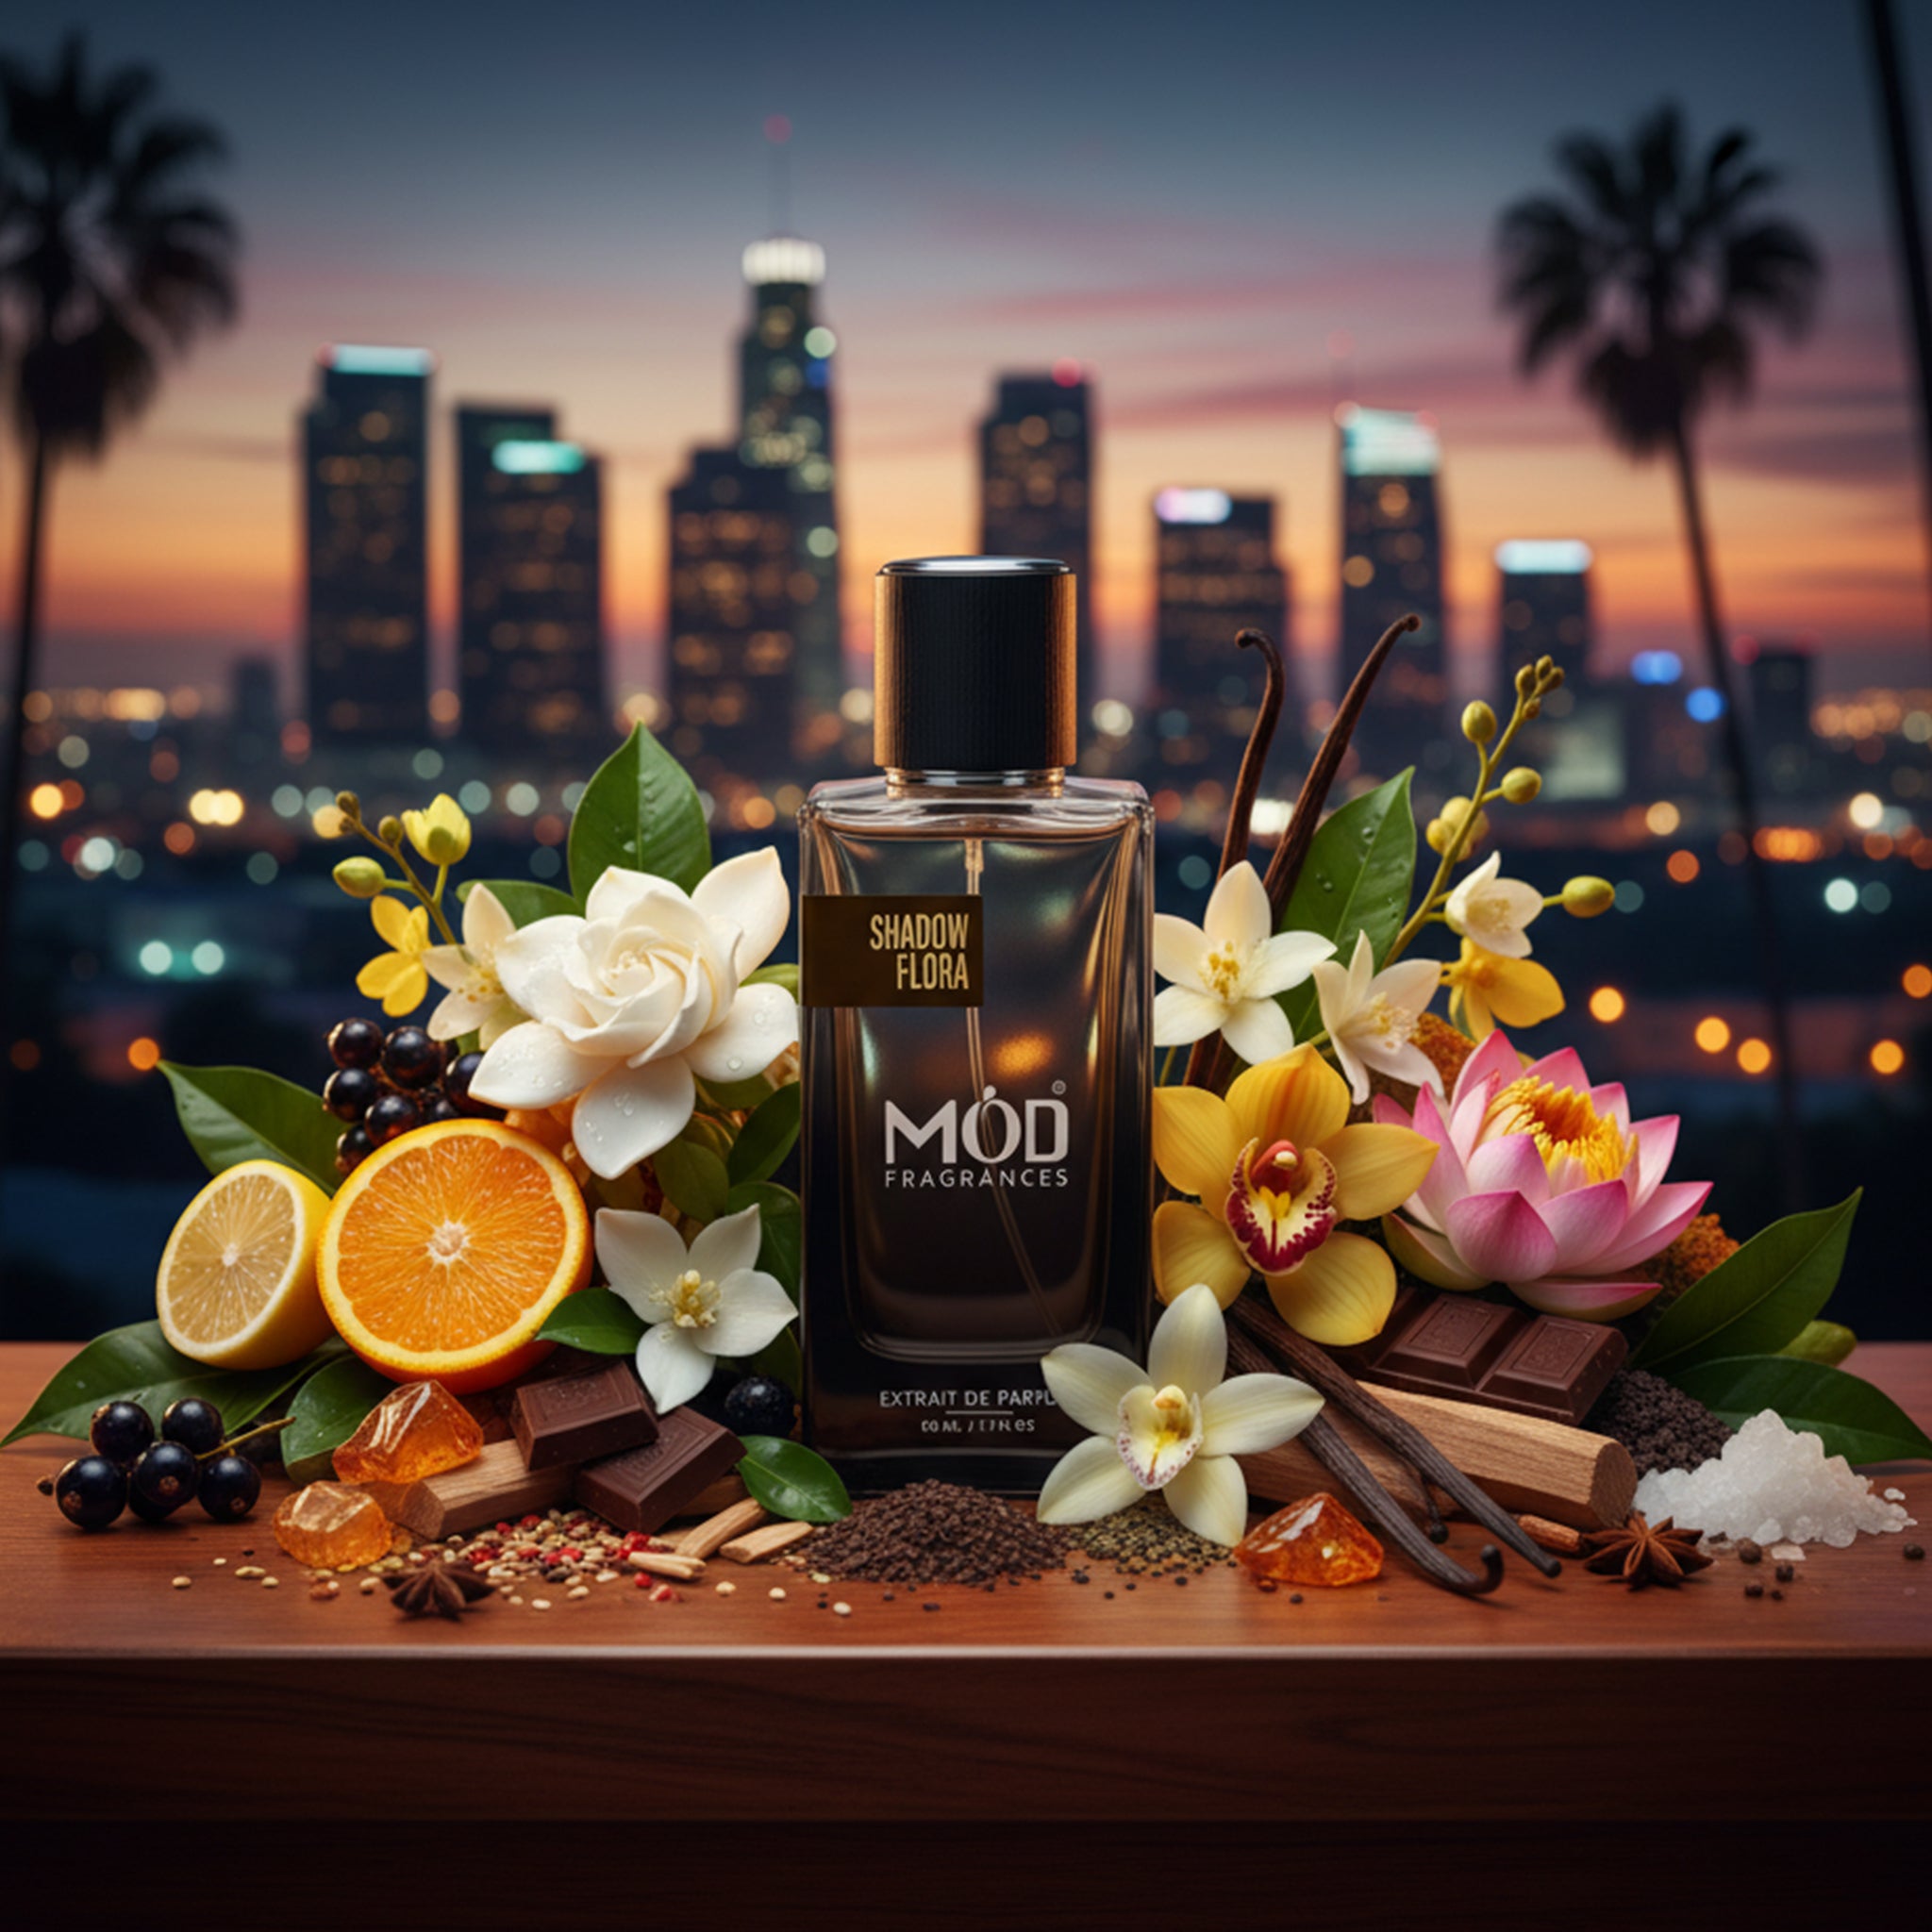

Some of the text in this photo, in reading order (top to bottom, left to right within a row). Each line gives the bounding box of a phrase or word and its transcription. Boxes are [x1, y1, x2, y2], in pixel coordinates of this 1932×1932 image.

[870, 912, 970, 951] SHADOW
[896, 952, 970, 991] FLORA
[885, 1168, 1069, 1189] FRAGRANCES
[878, 1390, 958, 1407] EXTRAIT
[964, 1390, 991, 1407] DE
